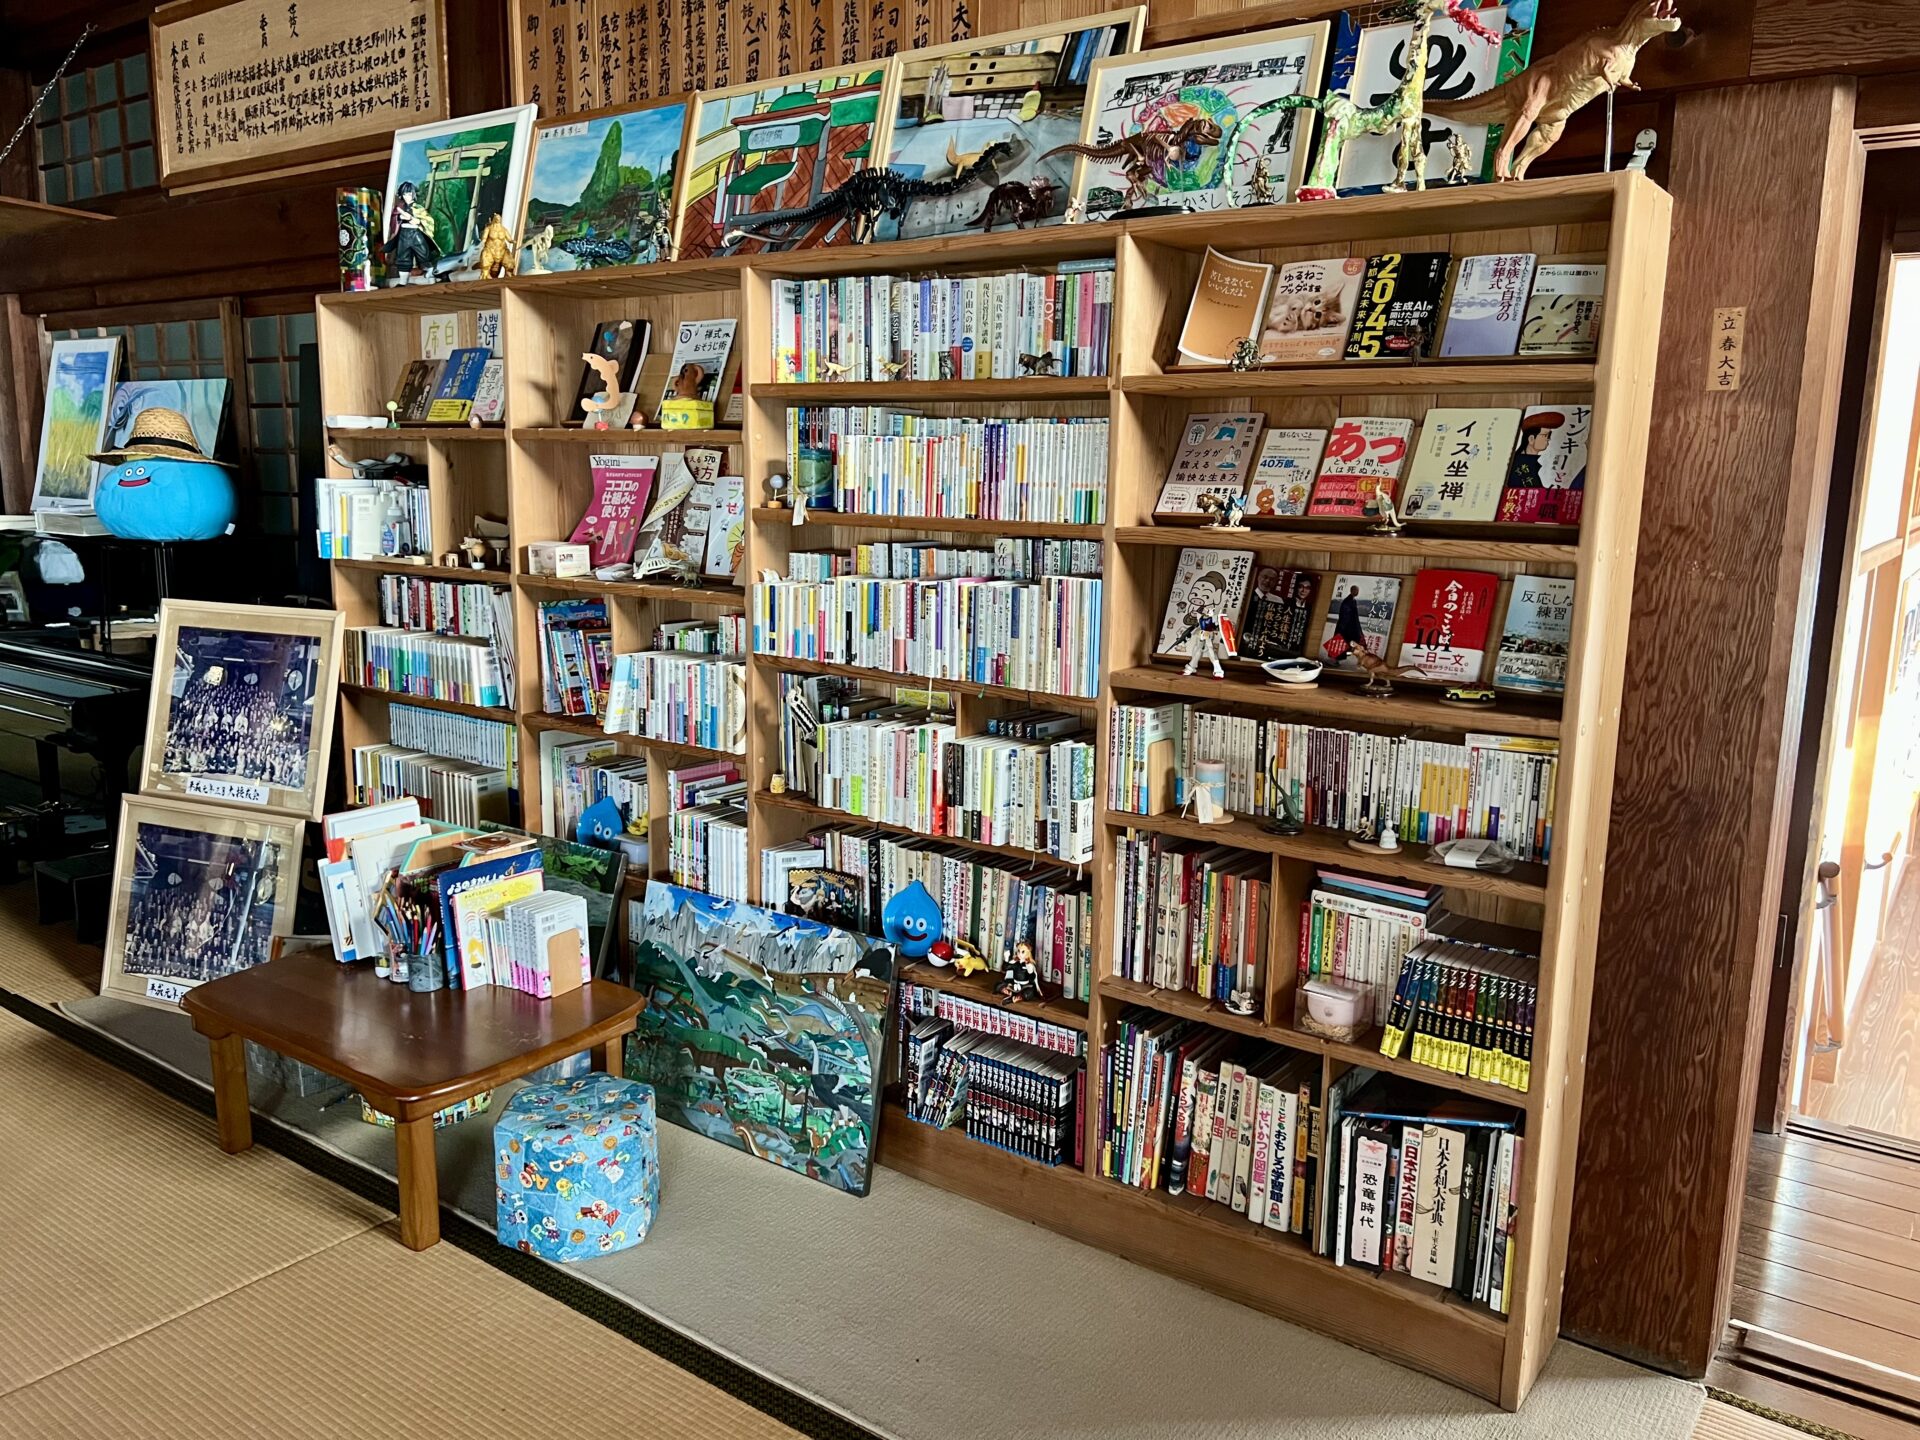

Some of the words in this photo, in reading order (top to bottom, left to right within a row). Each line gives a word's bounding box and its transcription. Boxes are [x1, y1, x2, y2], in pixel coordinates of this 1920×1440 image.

[1284, 270, 1324, 282] ゆるねこ
[1488, 256, 1507, 290] お葬式
[1496, 256, 1522, 322] 家族と自分の
[1044, 298, 1054, 323] JOY
[1359, 253, 1402, 358] 2045
[1718, 317, 1737, 386] 立春大吉
[1185, 448, 1222, 458] ブッダが
[1438, 420, 1478, 501] イス坐禅
[592, 456, 621, 469] Yogini
[1179, 460, 1210, 470] 教える
[1175, 473, 1239, 482] 愉快な生き方
[1325, 467, 1390, 476] 人は死ぬから
[605, 479, 639, 492] ココロの
[601, 491, 637, 505] 仕組みと
[601, 505, 631, 518] 使い方
[1438, 580, 1463, 646] 今日のことば
[1536, 606, 1567, 620] 練習
[1412, 652, 1469, 667] 一日一文。
[1055, 906, 1065, 945] 八犬伝
[1213, 1115, 1224, 1140] 昆虫
[1226, 1126, 1238, 1140] 花
[1239, 1134, 1250, 1147] 鳥
[1252, 1110, 1271, 1184] せいかつの図鑑
[1431, 1137, 1450, 1227] 日本名刹大事典
[1359, 1173, 1378, 1229] 恐竜時代
